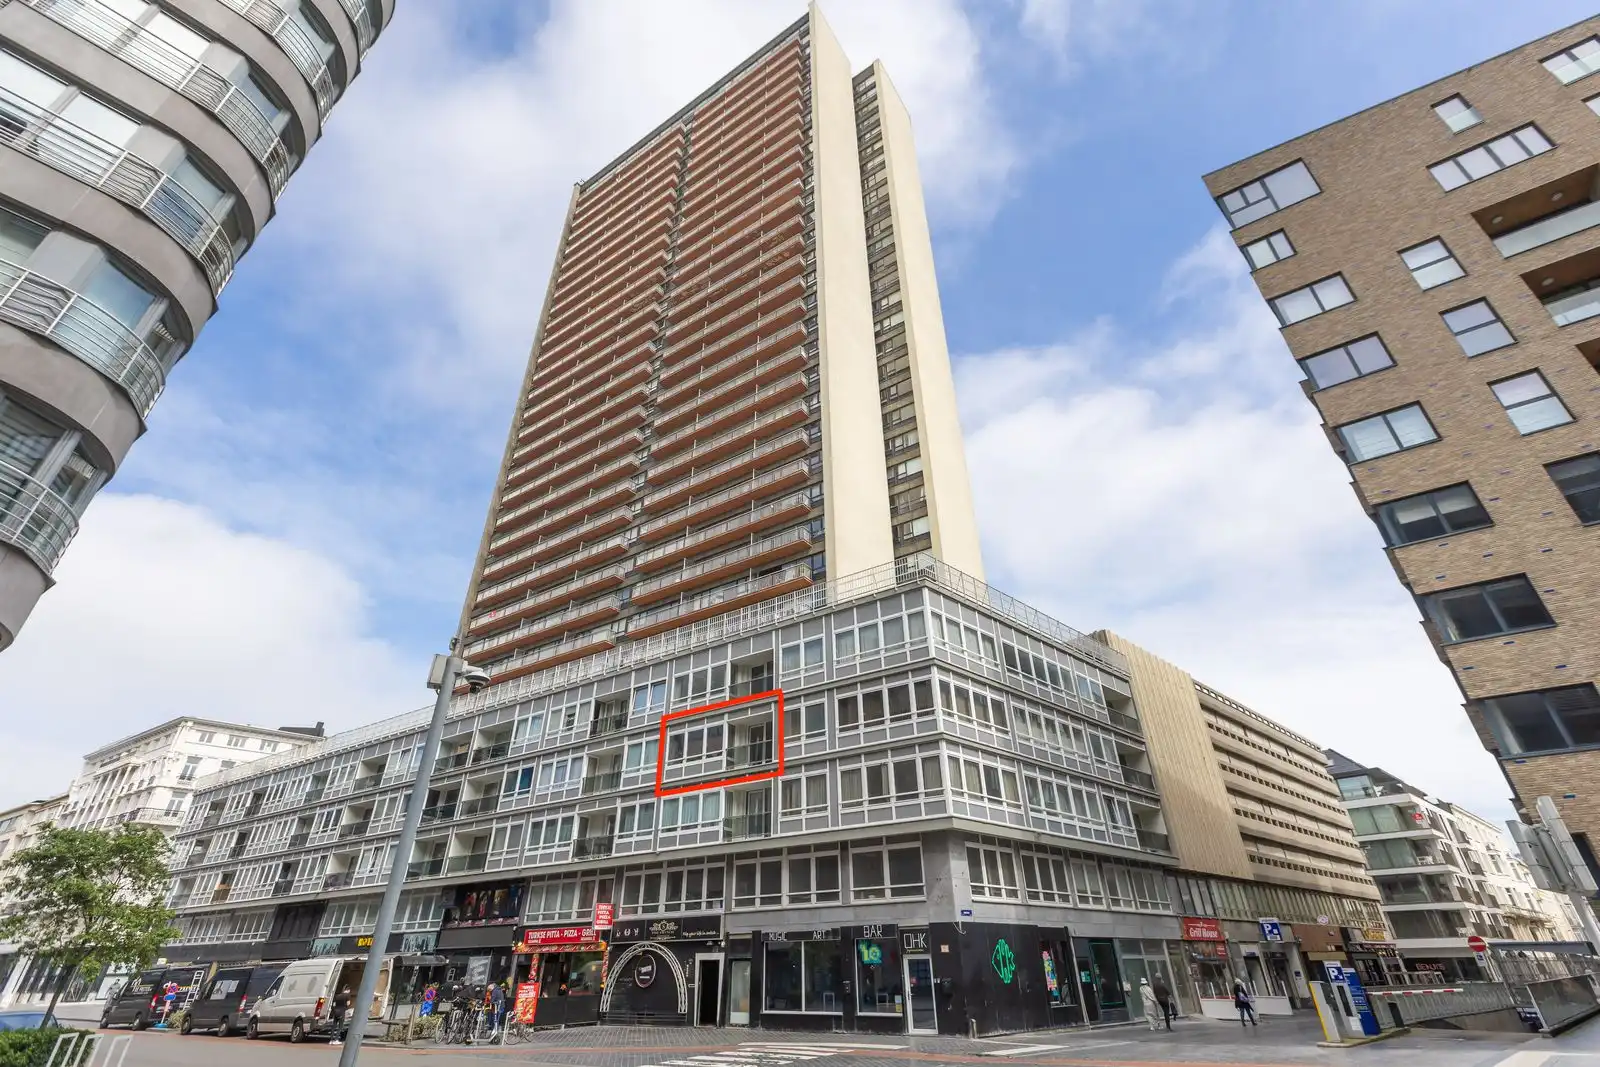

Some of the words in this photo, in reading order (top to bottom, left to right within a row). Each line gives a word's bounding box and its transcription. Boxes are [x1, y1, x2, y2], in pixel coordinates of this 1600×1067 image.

[528, 930, 546, 940] TURKSE
[546, 930, 560, 939] PITTA
[563, 929, 578, 937] PIZZA
[581, 928, 597, 937] GRILL
[768, 932, 788, 941] MUSIC
[812, 931, 825, 940] ART
[863, 925, 883, 938] BAR
[1189, 927, 1202, 937] Grill
[1202, 928, 1218, 938] House
[1327, 968, 1339, 980] P
